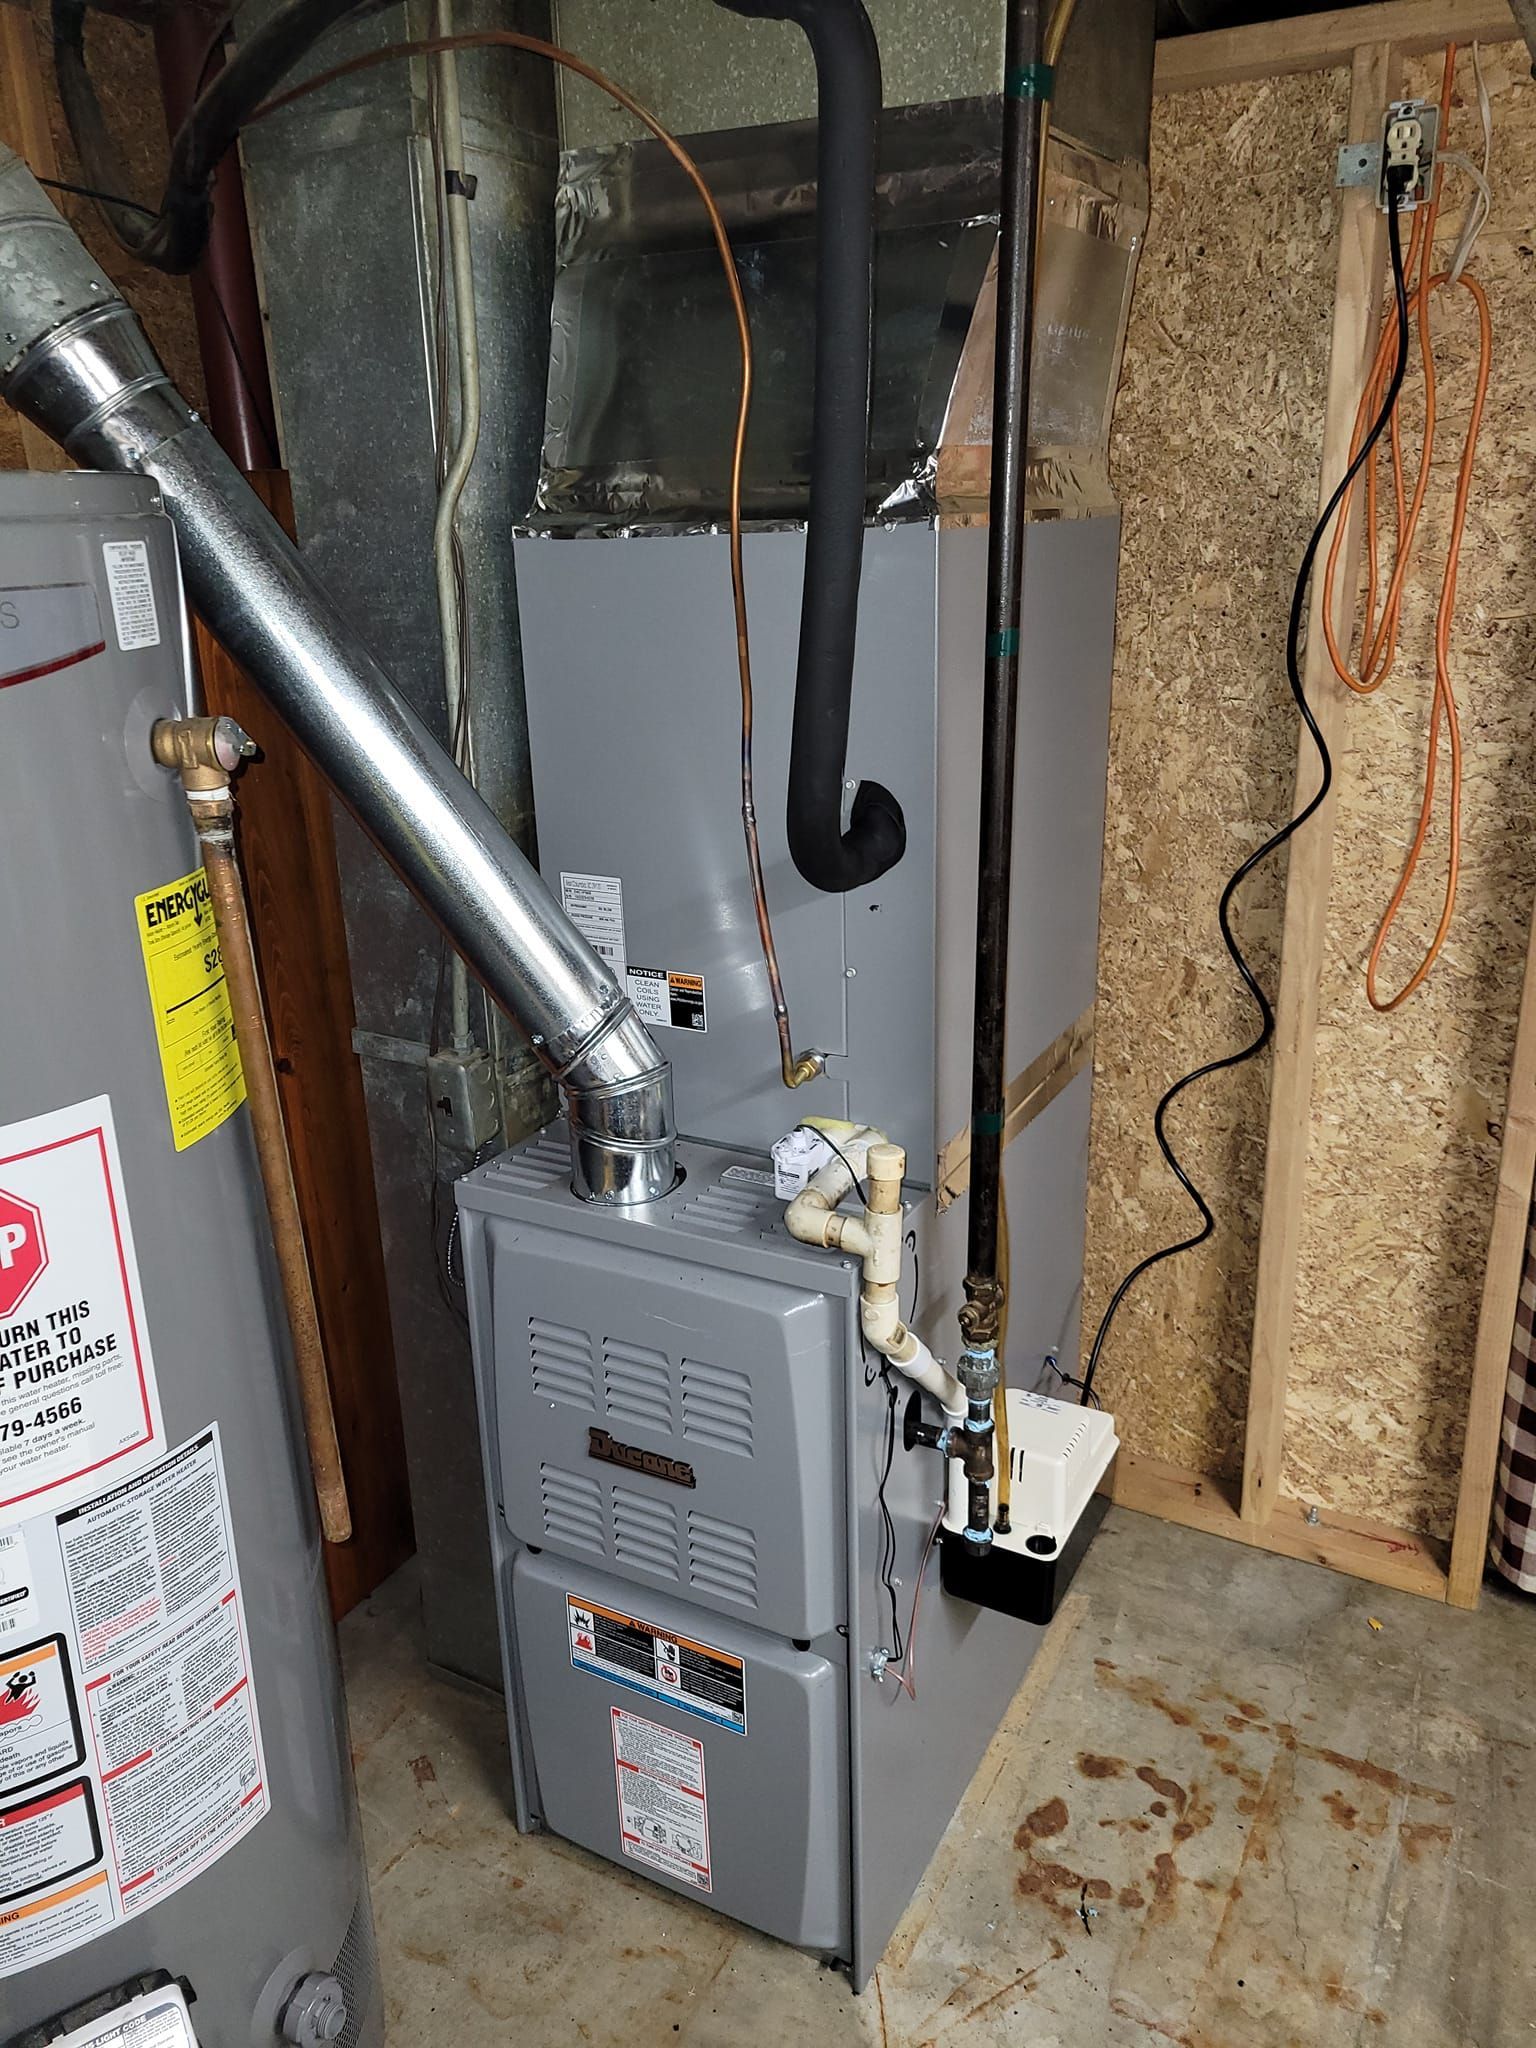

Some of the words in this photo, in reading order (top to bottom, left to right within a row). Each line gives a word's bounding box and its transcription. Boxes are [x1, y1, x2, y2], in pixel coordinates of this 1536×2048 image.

[629, 968, 664, 979] NOTICE
[634, 980, 660, 988] CLEAN
[636, 987, 659, 995] COILS
[637, 994, 660, 1003] USING
[636, 1001, 662, 1010] WATER
[45, 1300, 90, 1330] THIS
[56, 1327, 81, 1349] TO
[13, 1333, 117, 1389] PURCHASE
[1, 1397, 16, 1406] this
[18, 1388, 41, 1400] water
[72, 1363, 101, 1379] missing
[9, 1397, 39, 1415] general
[41, 1382, 79, 1401] questions
[81, 1374, 94, 1385] call
[95, 1369, 106, 1378] toll
[0, 1397, 82, 1441] 79-4566
[32, 1432, 53, 1443] days
[62, 1419, 85, 1431] week.
[2, 1455, 17, 1464] see
[19, 1449, 32, 1457] the
[35, 1436, 65, 1452] owner's
[67, 1422, 95, 1438] manual
[19, 1454, 42, 1467] water
[588, 1426, 695, 1489] Ducane
[78, 1488, 127, 1515] INSTALLATION
[127, 1479, 142, 1491] AND
[142, 1460, 176, 1482] OPERATION
[176, 1444, 199, 1463] DETAILS
[86, 1503, 126, 1524] AUTOMATIC
[127, 1486, 154, 1505] STORAGE
[155, 1473, 176, 1488] WATER
[176, 1459, 197, 1475] HEATER
[112, 1667, 125, 1678] FOR
[125, 1659, 140, 1671] YOUR
[141, 1647, 161, 1662] SAFETY
[162, 1638, 175, 1649] READ
[176, 1625, 195, 1641] BEFORE
[196, 1607, 219, 1626] OPERATING
[637, 1623, 678, 1644] WARNING
[155, 1735, 179, 1752] LIGHTING
[179, 1710, 213, 1736] INSTRUCTIONS
[11, 1755, 33, 1768] vapors
[35, 1749, 46, 1757] and
[48, 1740, 68, 1751] liquids
[47, 1745, 72, 1759] gasoline
[48, 1754, 64, 1764] other
[38, 1829, 54, 1838] elderly
[165, 1856, 178, 1867] TURN
[217, 1807, 240, 1828] APPLIANCE
[122, 2015, 147, 2031] CODE
